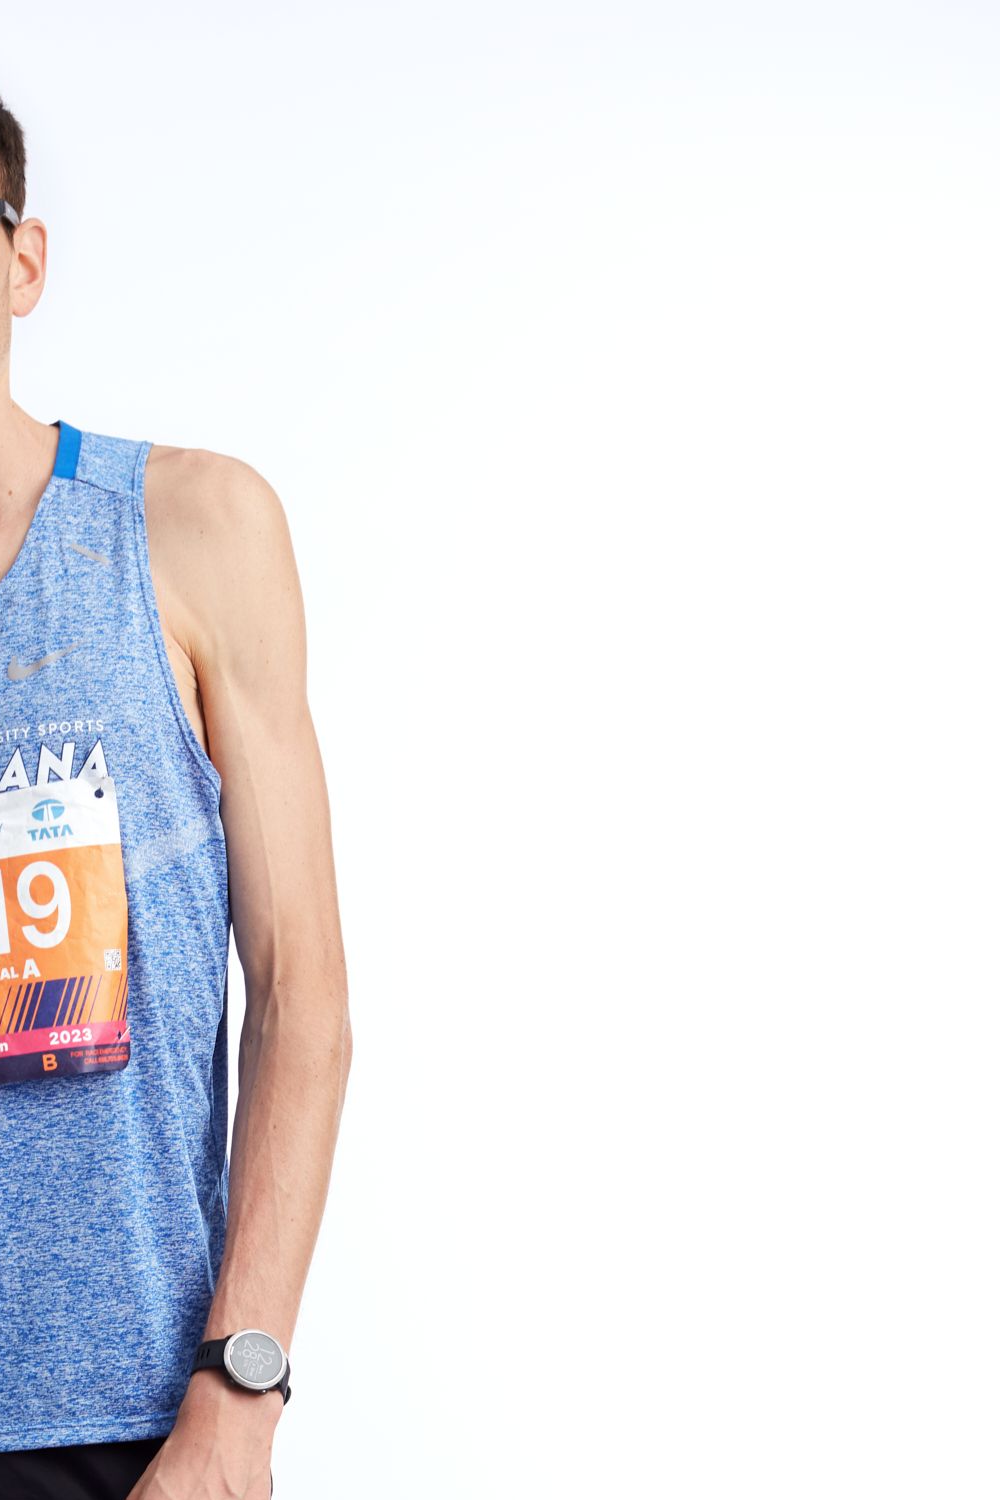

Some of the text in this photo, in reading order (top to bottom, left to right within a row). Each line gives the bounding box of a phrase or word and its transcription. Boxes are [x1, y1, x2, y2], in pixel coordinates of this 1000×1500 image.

[38, 719, 105, 737] SPORTS
[27, 823, 74, 842] TATA
[22, 958, 41, 980] A
[49, 1028, 92, 1045] 2023
[42, 1053, 58, 1071] B
